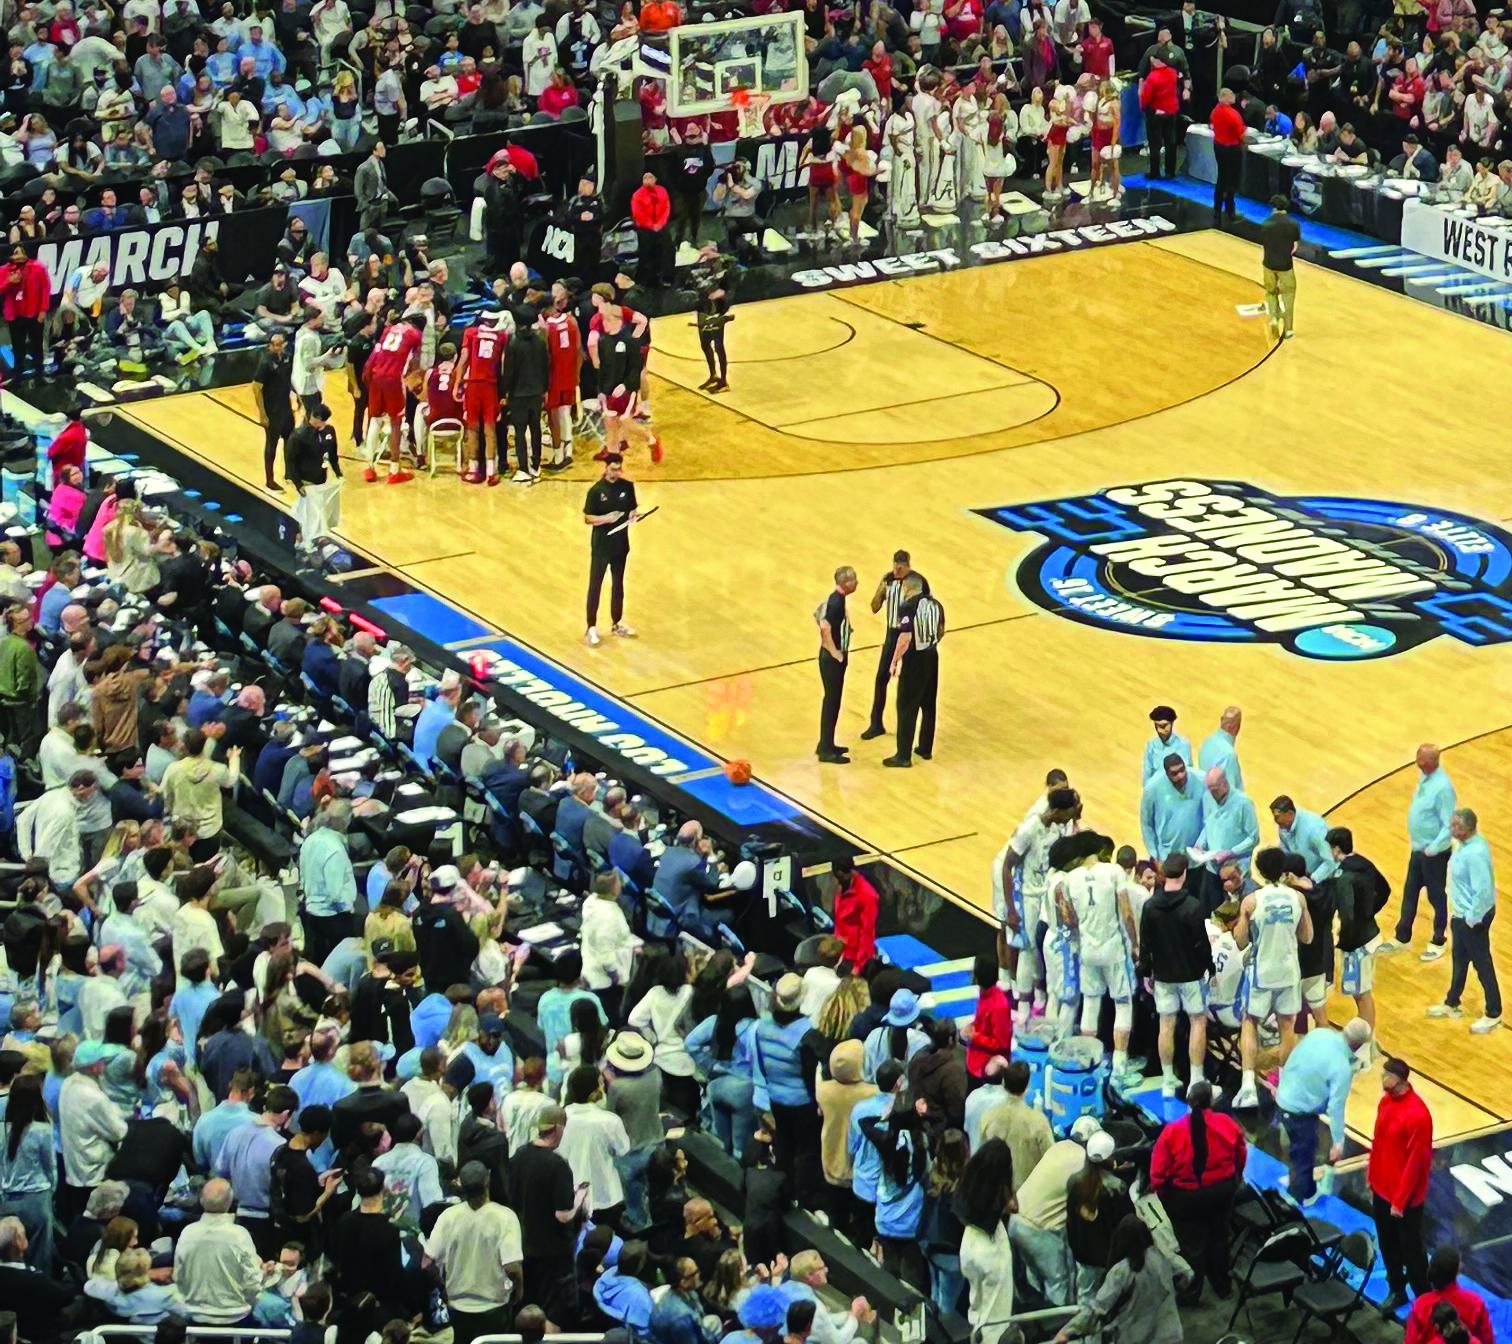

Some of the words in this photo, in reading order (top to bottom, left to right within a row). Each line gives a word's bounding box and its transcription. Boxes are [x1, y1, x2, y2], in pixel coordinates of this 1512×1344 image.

[791, 248, 961, 288] SWEET
[970, 214, 1177, 260] SIXTEEN
[1443, 216, 1499, 271] WEST
[1105, 479, 1437, 602] MADNESS
[1431, 521, 1497, 554] ELITE
[1078, 590, 1176, 629] SWEET
[1090, 533, 1366, 632] MARCH
[1087, 886, 1096, 907] 1
